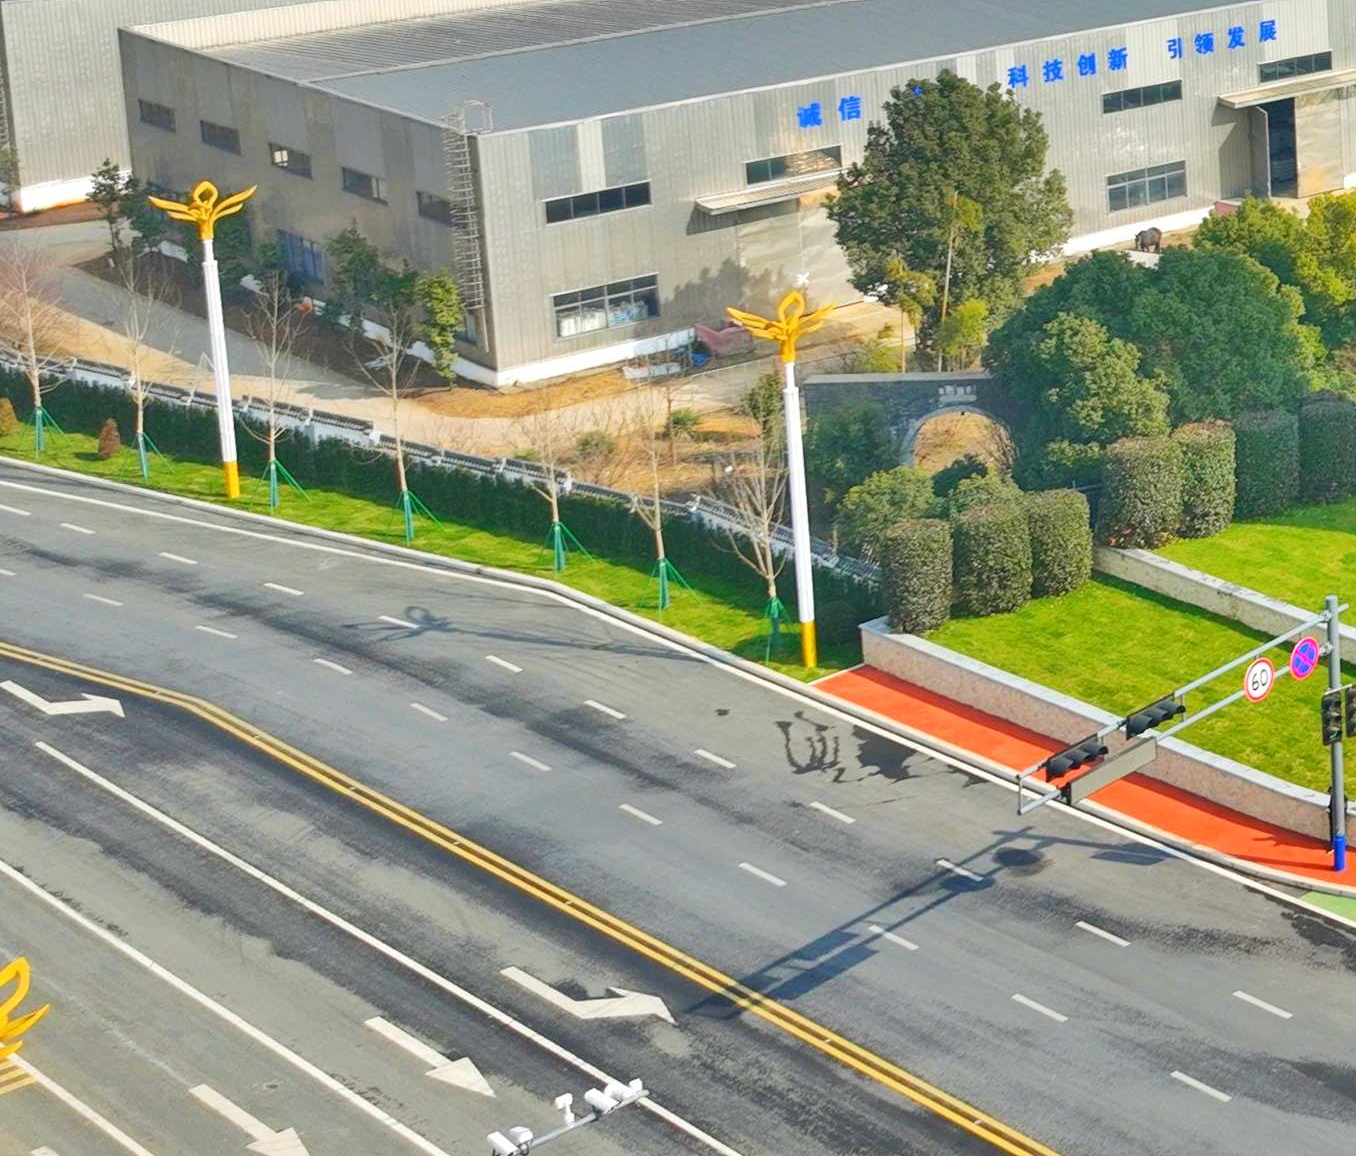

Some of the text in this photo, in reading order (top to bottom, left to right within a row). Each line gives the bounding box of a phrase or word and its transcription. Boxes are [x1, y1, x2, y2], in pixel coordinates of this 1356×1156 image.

[797, 18, 1278, 128] 诚信 科技创新 引领发展
[1252, 668, 1268, 691] 60
